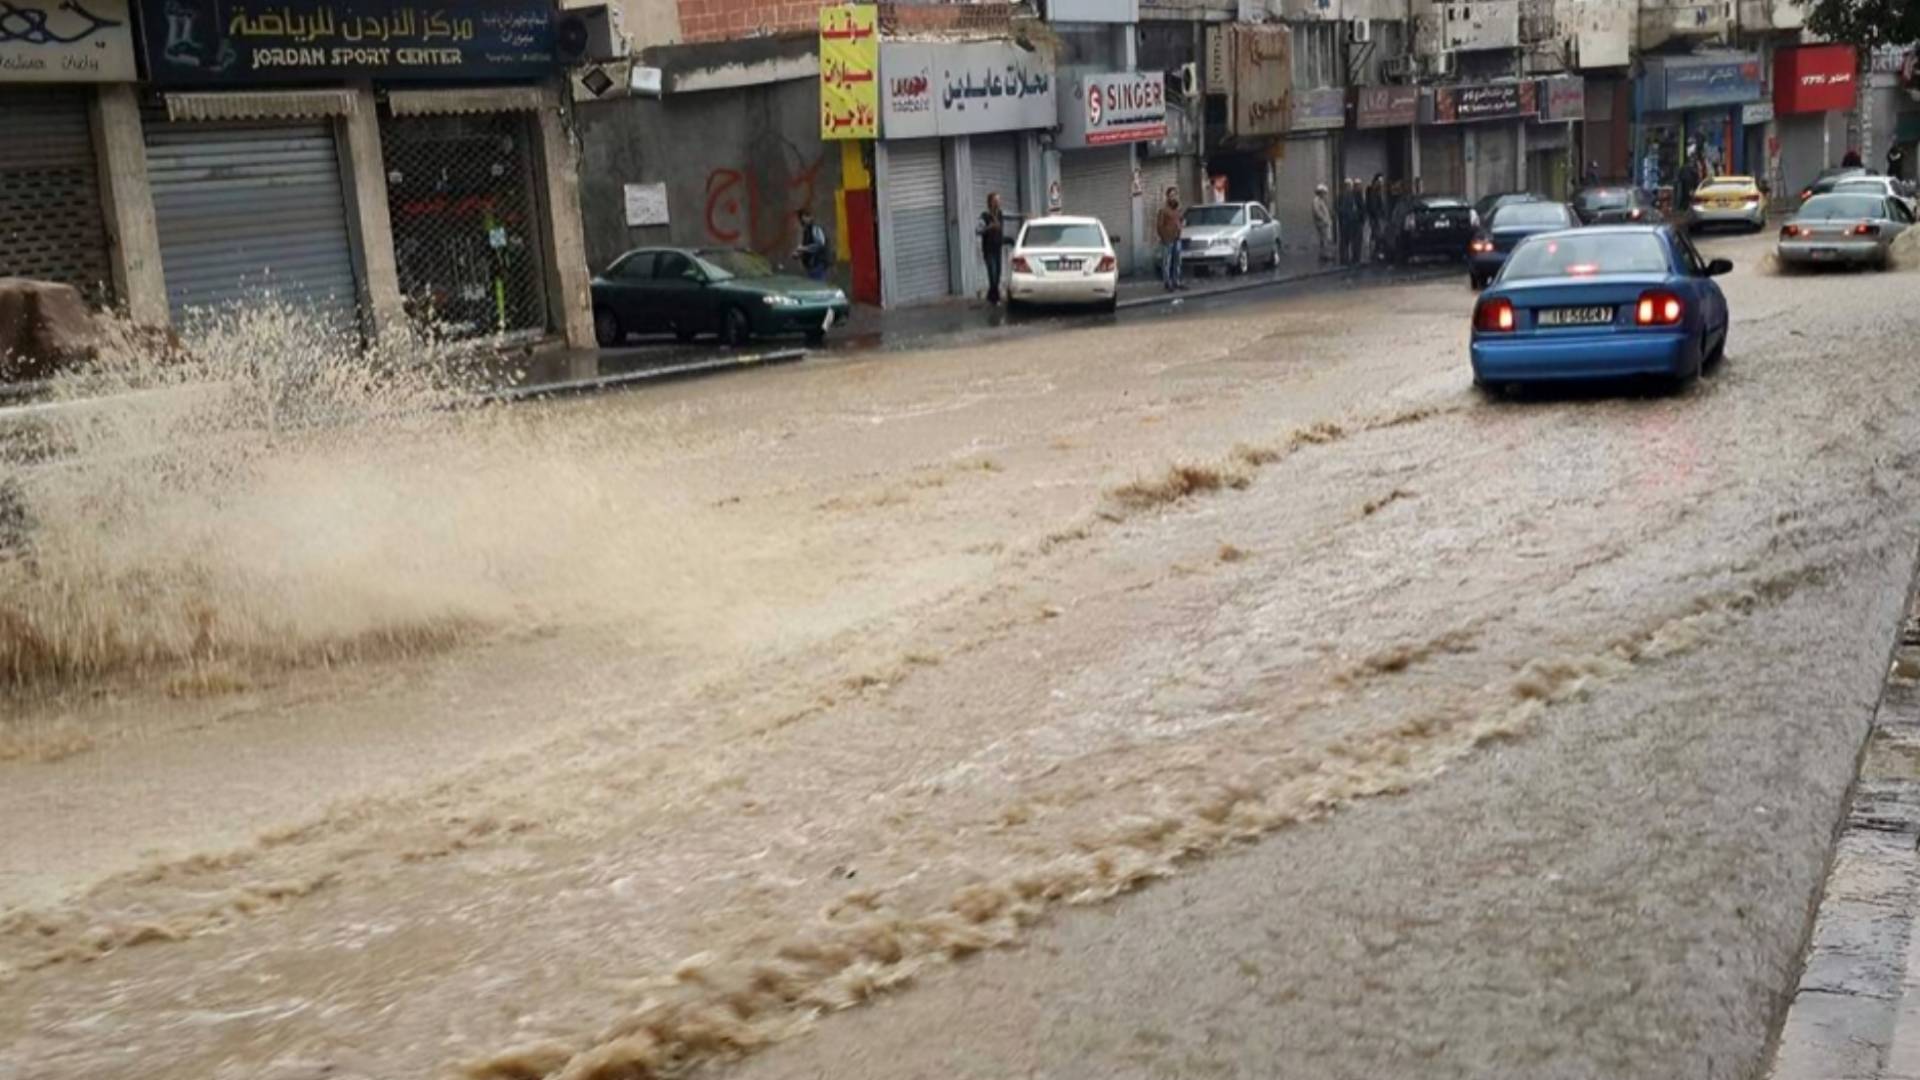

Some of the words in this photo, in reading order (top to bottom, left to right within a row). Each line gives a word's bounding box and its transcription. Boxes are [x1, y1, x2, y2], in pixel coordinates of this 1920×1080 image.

[229, 6, 334, 42] للرياضة
[421, 9, 473, 41] مركز
[822, 11, 873, 45] موقف
[252, 48, 325, 69] JORDAN
[331, 48, 391, 66] SPORT
[396, 48, 462, 66] CENTER
[824, 58, 873, 89] سيارات
[943, 66, 1002, 110] عابدين
[1005, 61, 1048, 98] محلات
[1107, 81, 1162, 111] SINGER
